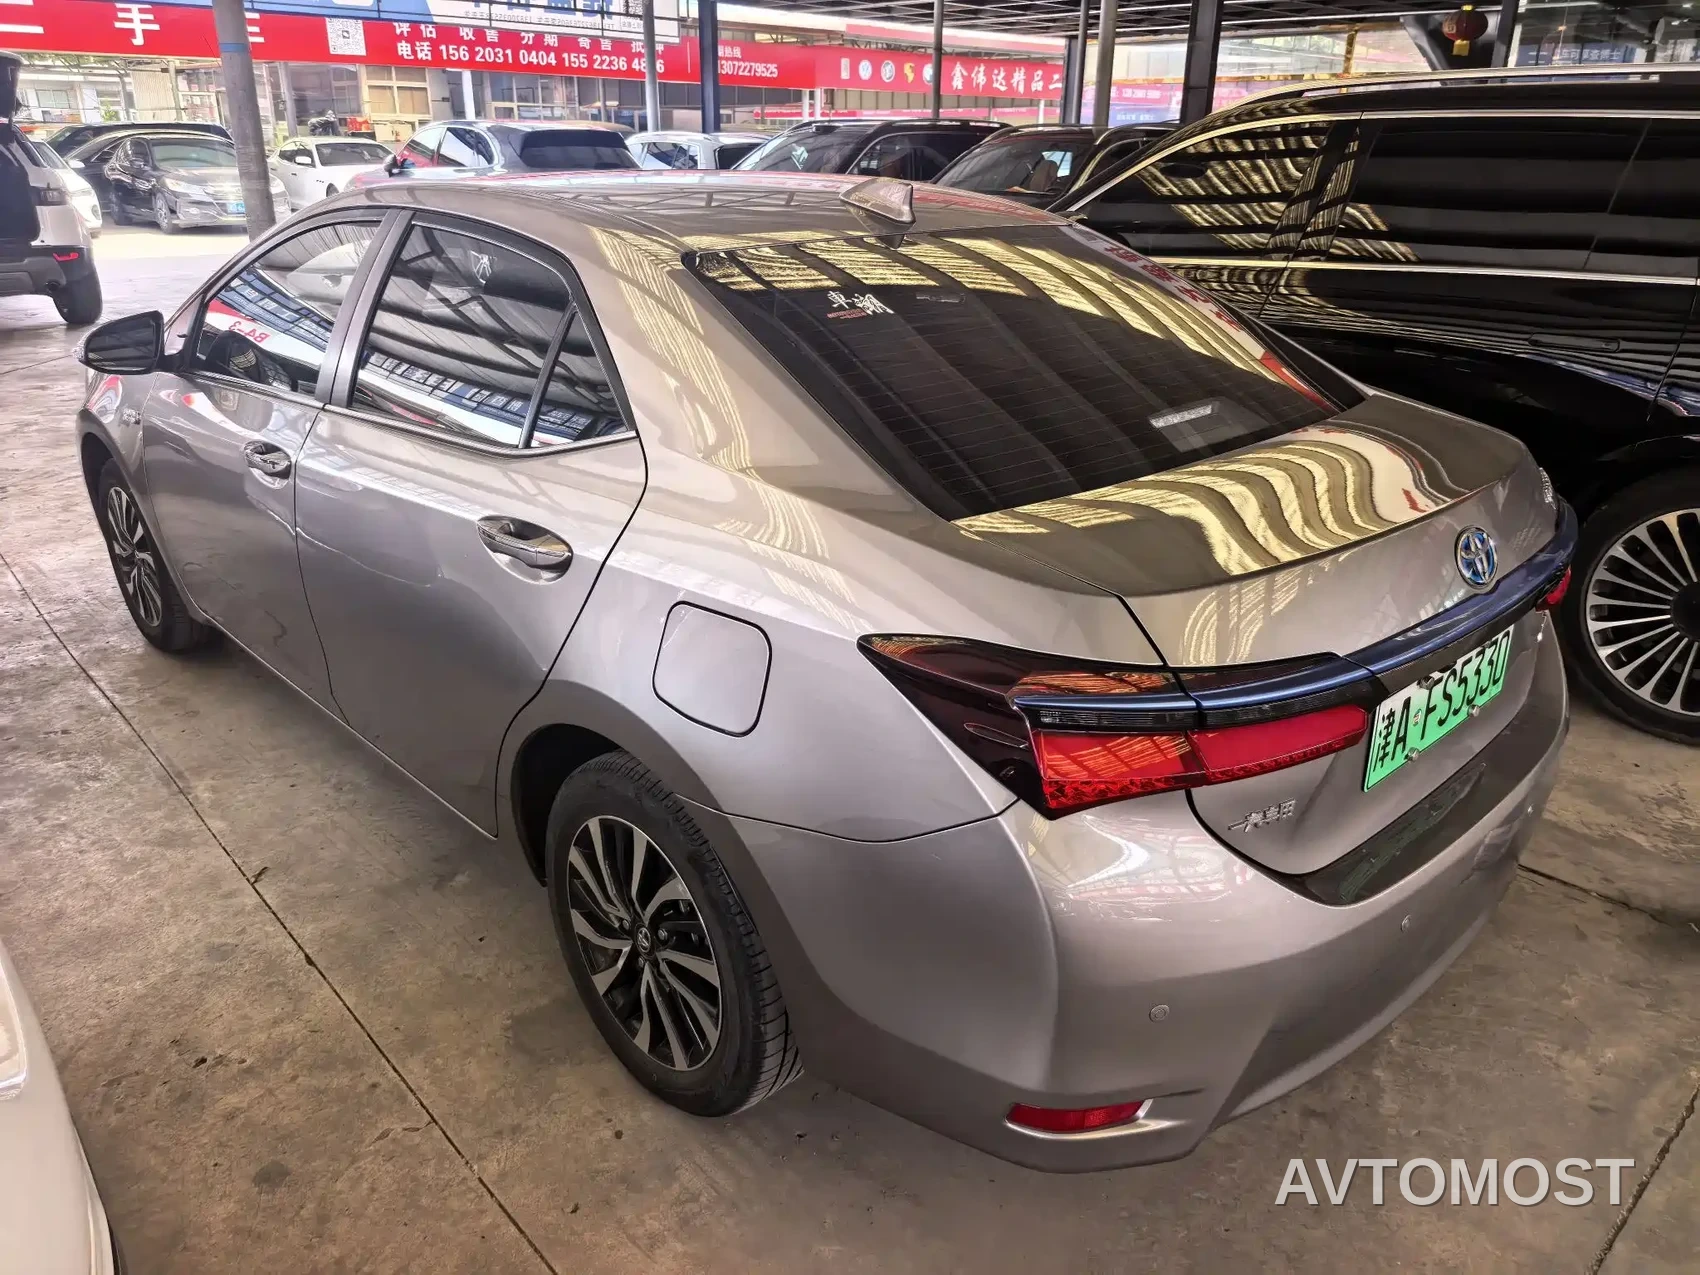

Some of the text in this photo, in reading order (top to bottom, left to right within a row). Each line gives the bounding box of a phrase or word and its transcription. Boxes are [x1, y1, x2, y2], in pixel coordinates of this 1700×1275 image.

[396, 40, 665, 73] 电话 156 2031 0404 155 2236 486
[717, 60, 778, 77] 13072279525
